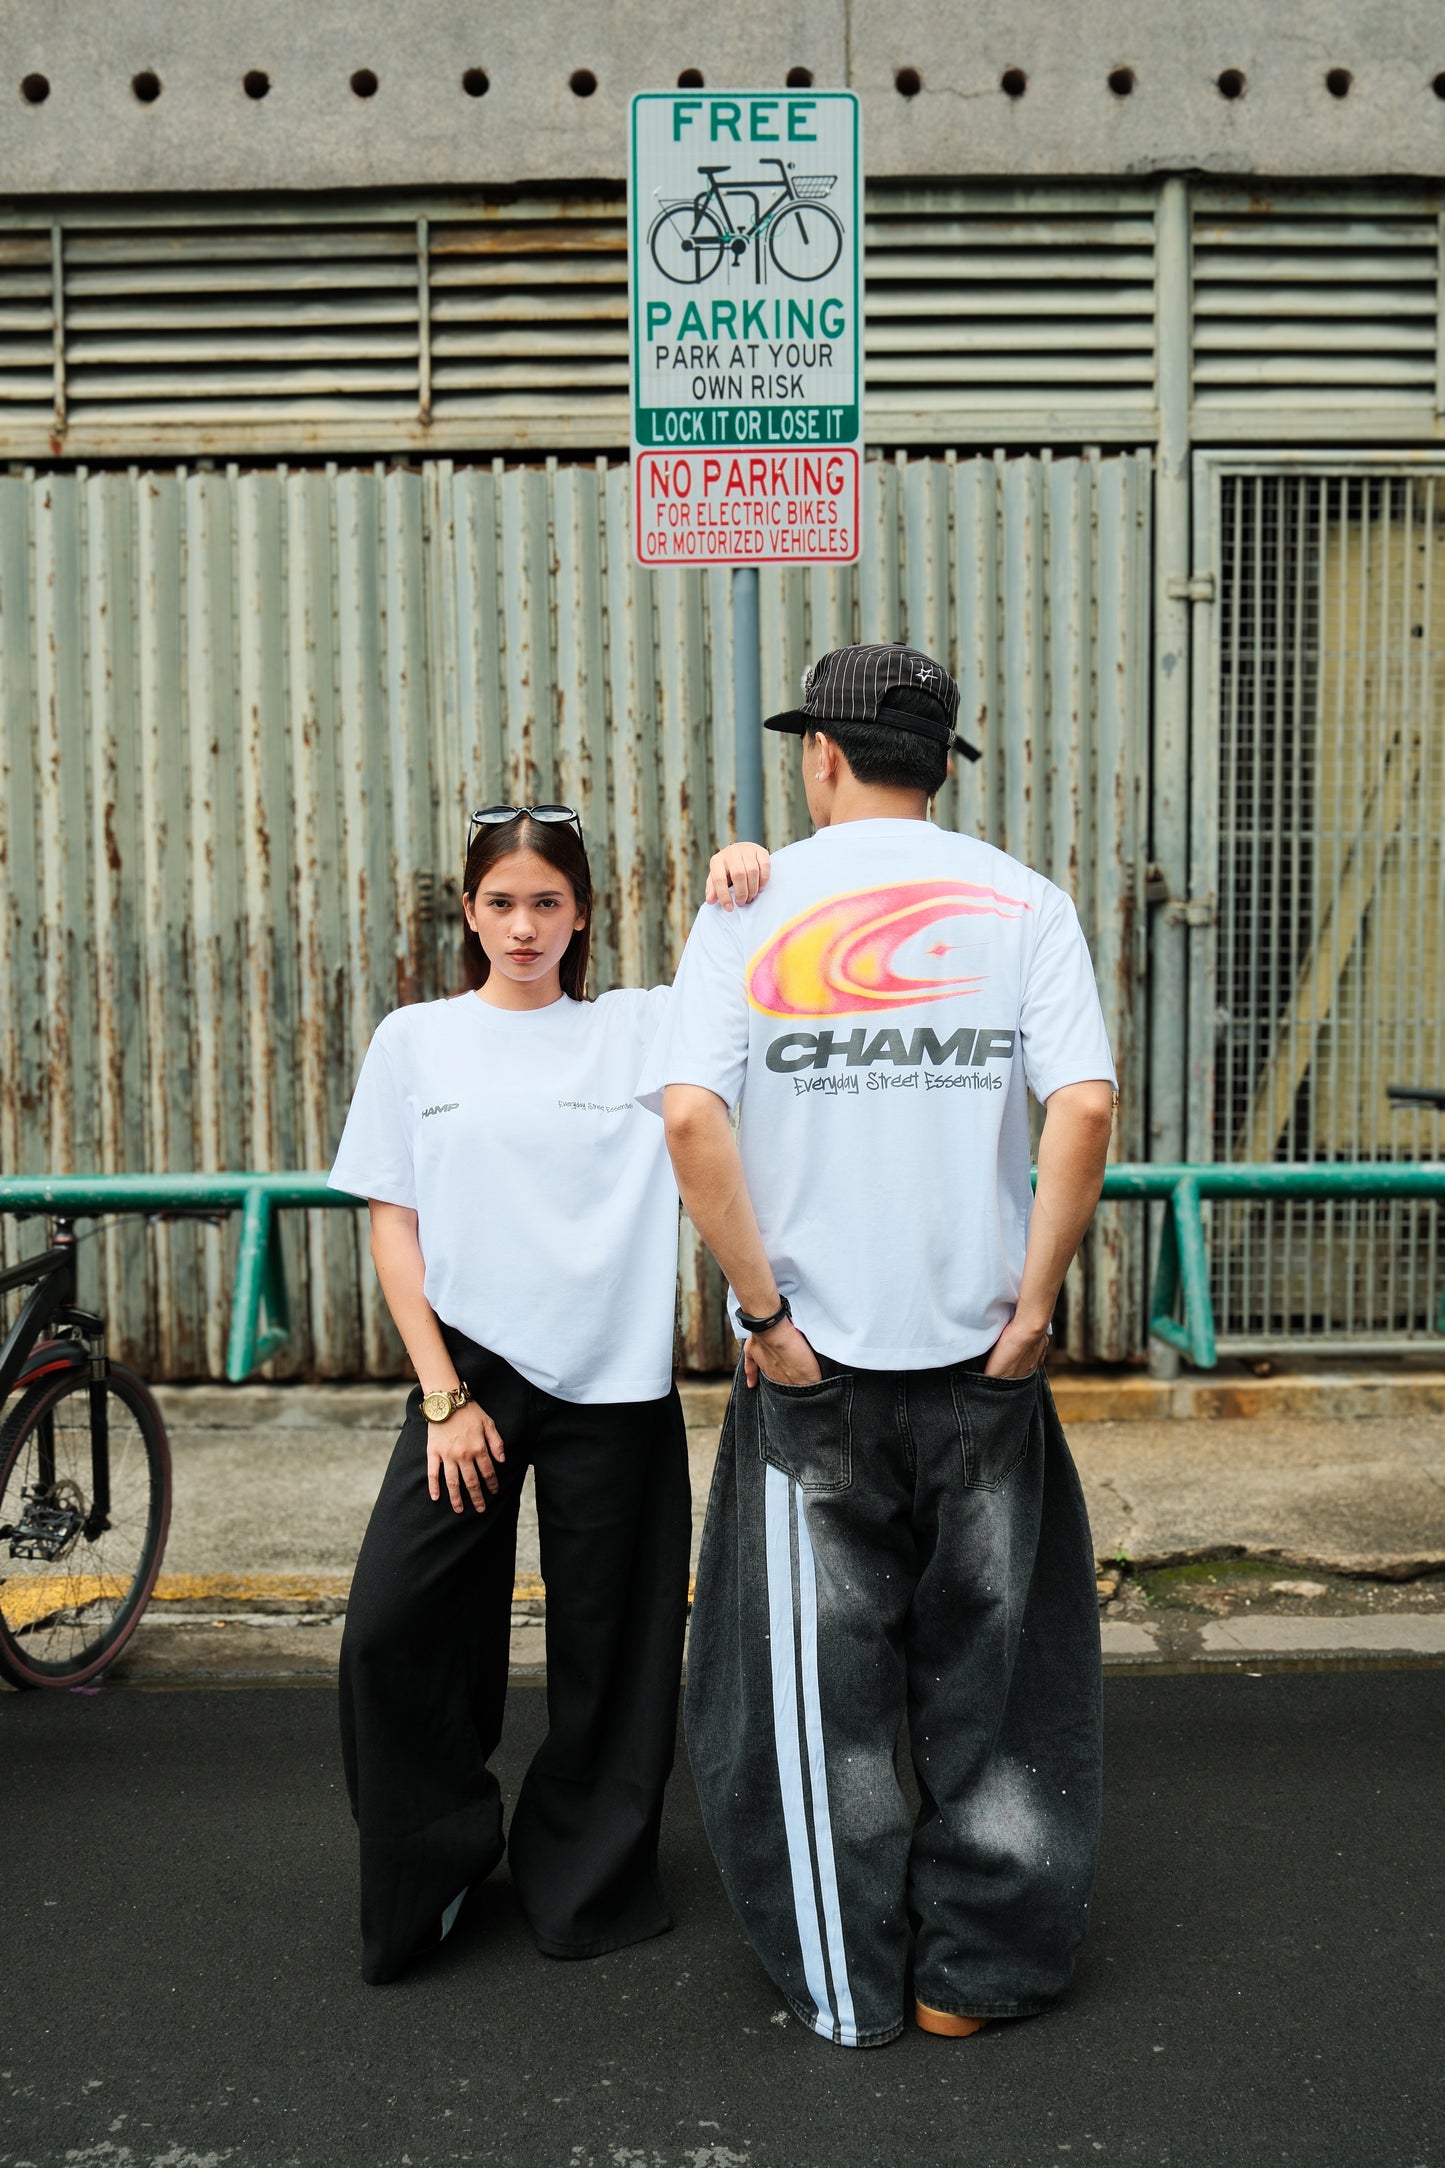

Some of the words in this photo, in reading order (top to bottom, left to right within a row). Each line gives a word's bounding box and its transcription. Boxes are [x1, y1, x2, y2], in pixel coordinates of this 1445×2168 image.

[673, 101, 818, 142] FREE
[646, 298, 846, 341] PARKING
[656, 345, 721, 369] PARK
[729, 344, 760, 368] AT
[768, 344, 833, 367] YOUR
[692, 375, 743, 400] OWN
[751, 374, 805, 398] RISK
[651, 411, 706, 442] LOCK
[711, 411, 729, 441] IT
[734, 410, 762, 441] OR
[767, 409, 820, 440] LOSE
[826, 409, 844, 439] IT
[650, 459, 692, 499] NO
[703, 456, 845, 498] PARKING
[656, 503, 691, 527] FOR
[697, 501, 782, 526] ELECTRIC
[787, 500, 838, 525] BIKES
[646, 532, 668, 555] OR
[673, 530, 764, 554] MOTORIZED
[769, 528, 849, 553] VEHICLES
[765, 1027, 1017, 1074] CHAMP
[793, 1073, 860, 1097] Everyday
[866, 1071, 919, 1091] Street
[924, 1071, 1003, 1092] Essentials
[421, 1102, 460, 1120] HAMP
